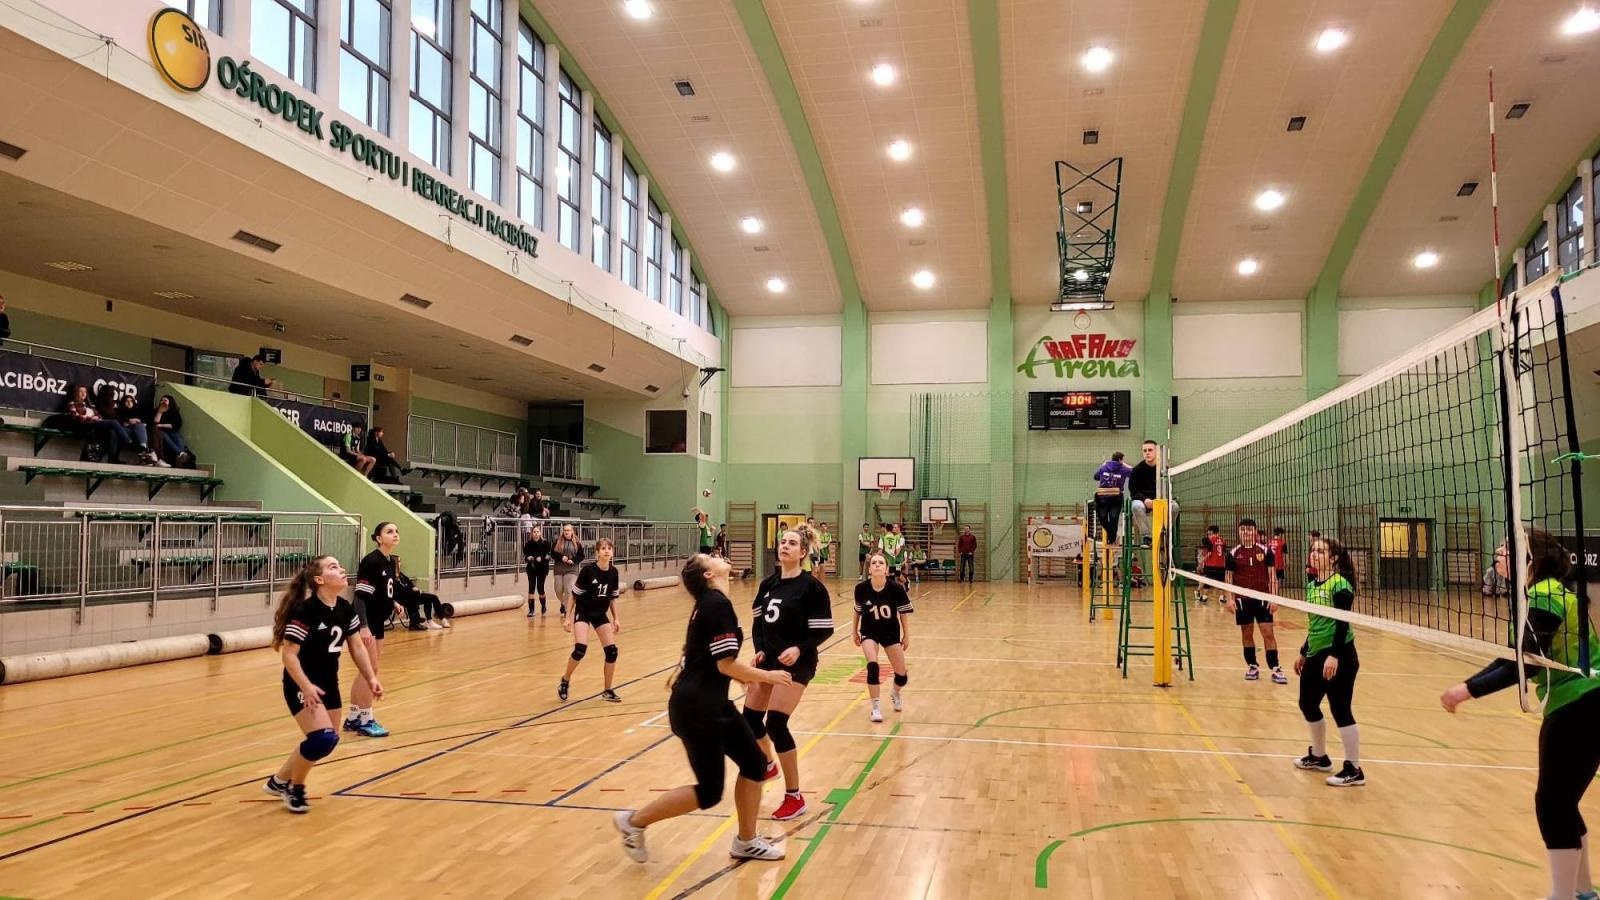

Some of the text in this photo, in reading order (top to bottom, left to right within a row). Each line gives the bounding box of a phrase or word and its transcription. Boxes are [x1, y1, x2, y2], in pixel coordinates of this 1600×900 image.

[217, 56, 539, 258] OŚRODEK SPORTU I REKREACJI RACIBÓRZ
[1017, 335, 1141, 379] Arena
[356, 370, 366, 380] F
[387, 578, 394, 598] 6
[597, 583, 608, 597] 11
[764, 598, 782, 623] 5
[869, 604, 892, 620] 10
[328, 626, 343, 653] 2
